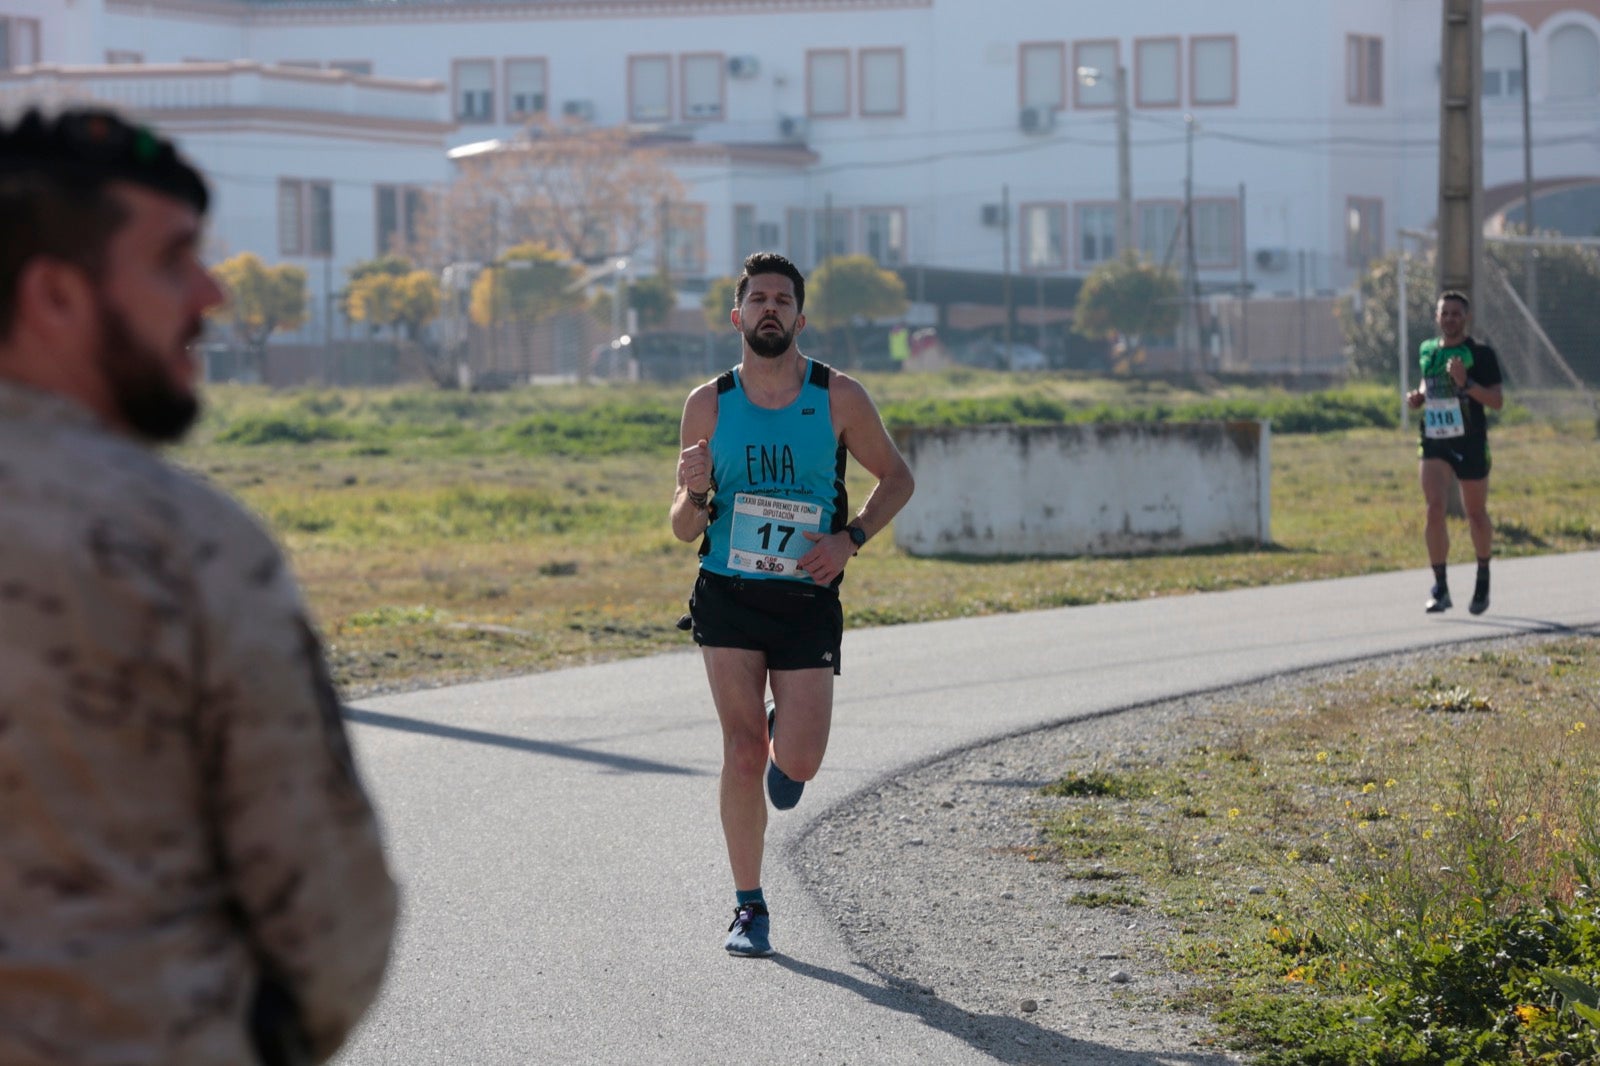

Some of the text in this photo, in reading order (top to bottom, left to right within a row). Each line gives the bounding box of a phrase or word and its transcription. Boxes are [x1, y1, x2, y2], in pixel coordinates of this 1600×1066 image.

[746, 445, 794, 485] ENA
[757, 498, 771, 507] GRAN
[772, 501, 793, 511] PREMIO
[793, 504, 801, 512] DE
[757, 522, 795, 553] 17
